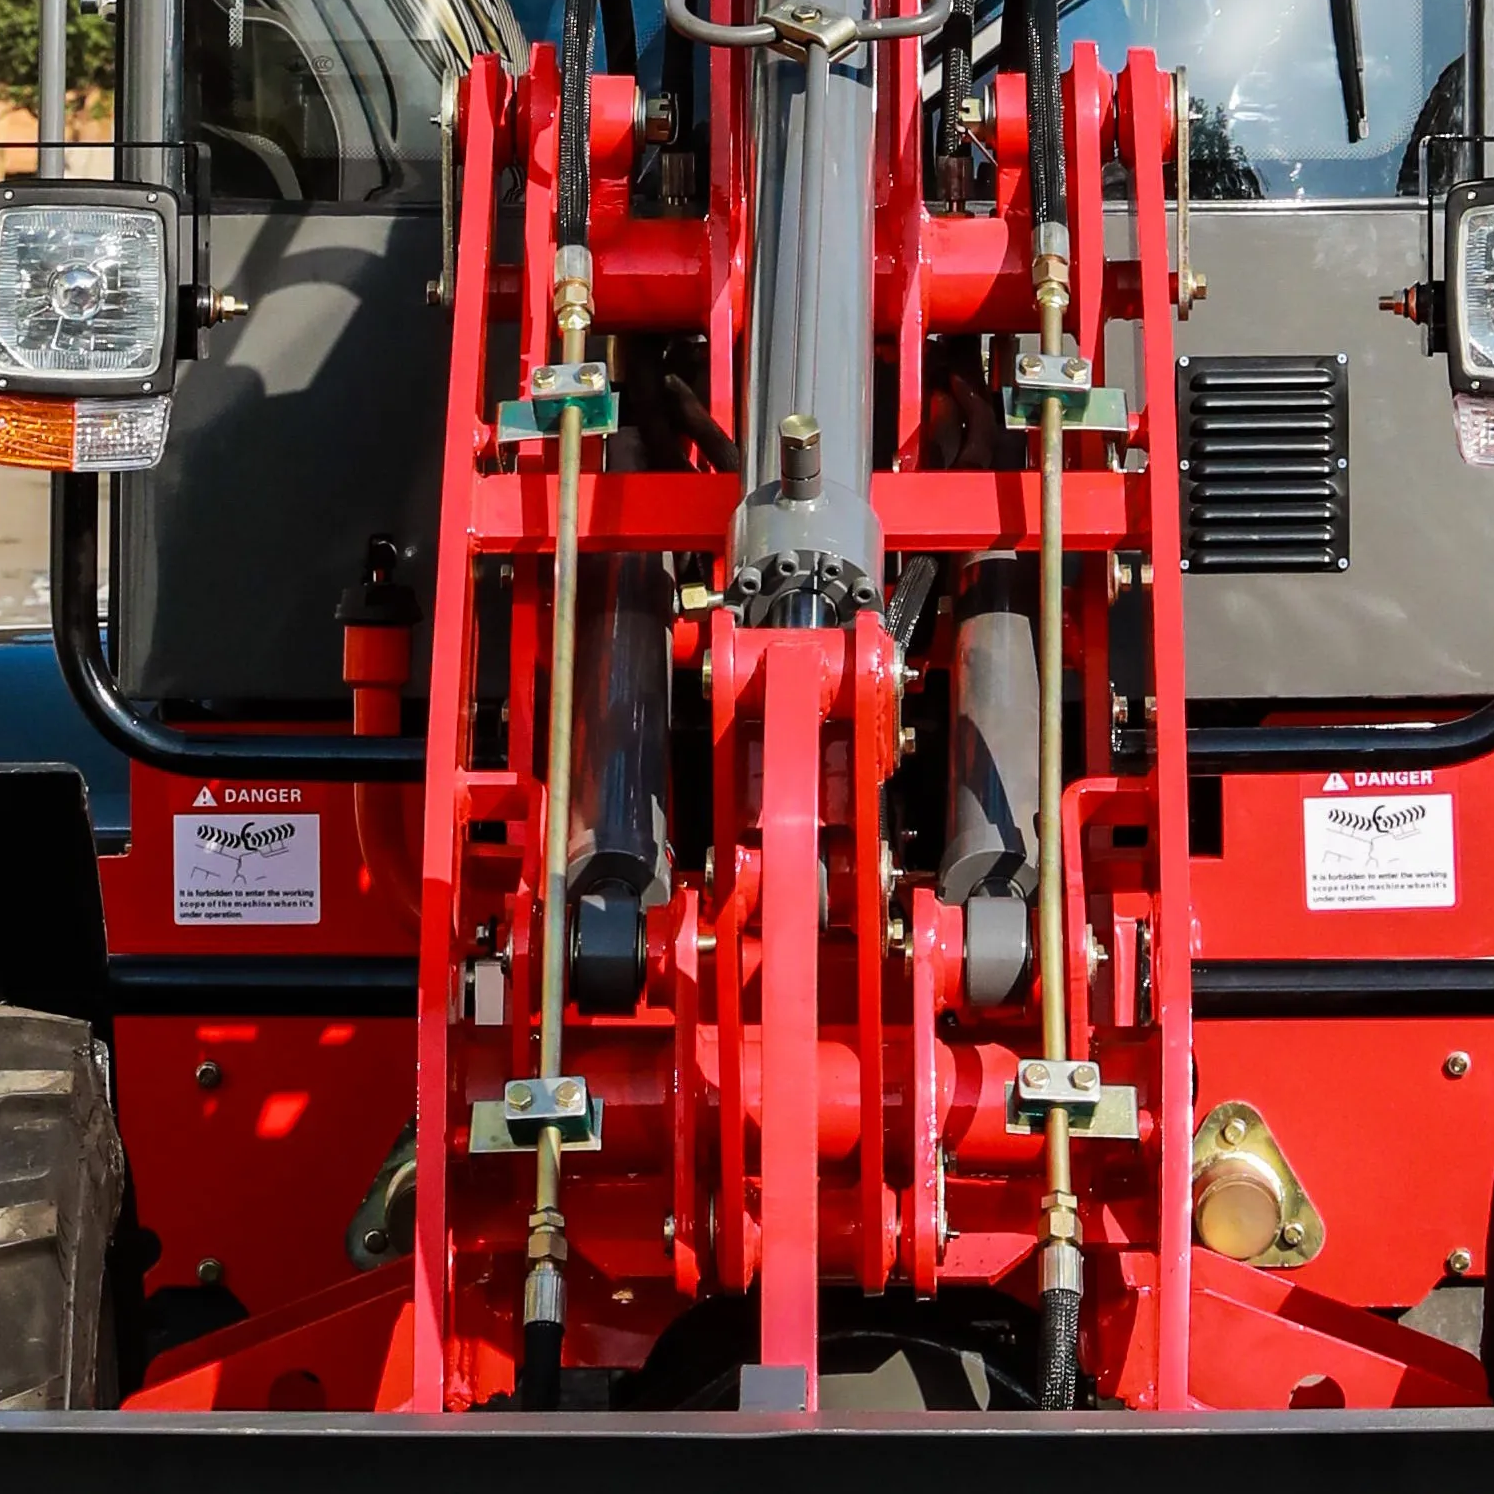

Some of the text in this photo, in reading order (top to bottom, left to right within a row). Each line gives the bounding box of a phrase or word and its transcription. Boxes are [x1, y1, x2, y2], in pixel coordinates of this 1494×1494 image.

[1354, 771, 1433, 786] DANGER
[224, 788, 302, 803] DANGER
[1415, 871, 1447, 880] working
[1312, 885, 1338, 893] scope
[1367, 882, 1405, 890] machine
[1407, 881, 1431, 890] when
[195, 889, 233, 897] forbidden
[282, 889, 314, 898] working
[1313, 894, 1336, 902] under
[179, 901, 205, 909] scope
[179, 910, 202, 918] under
